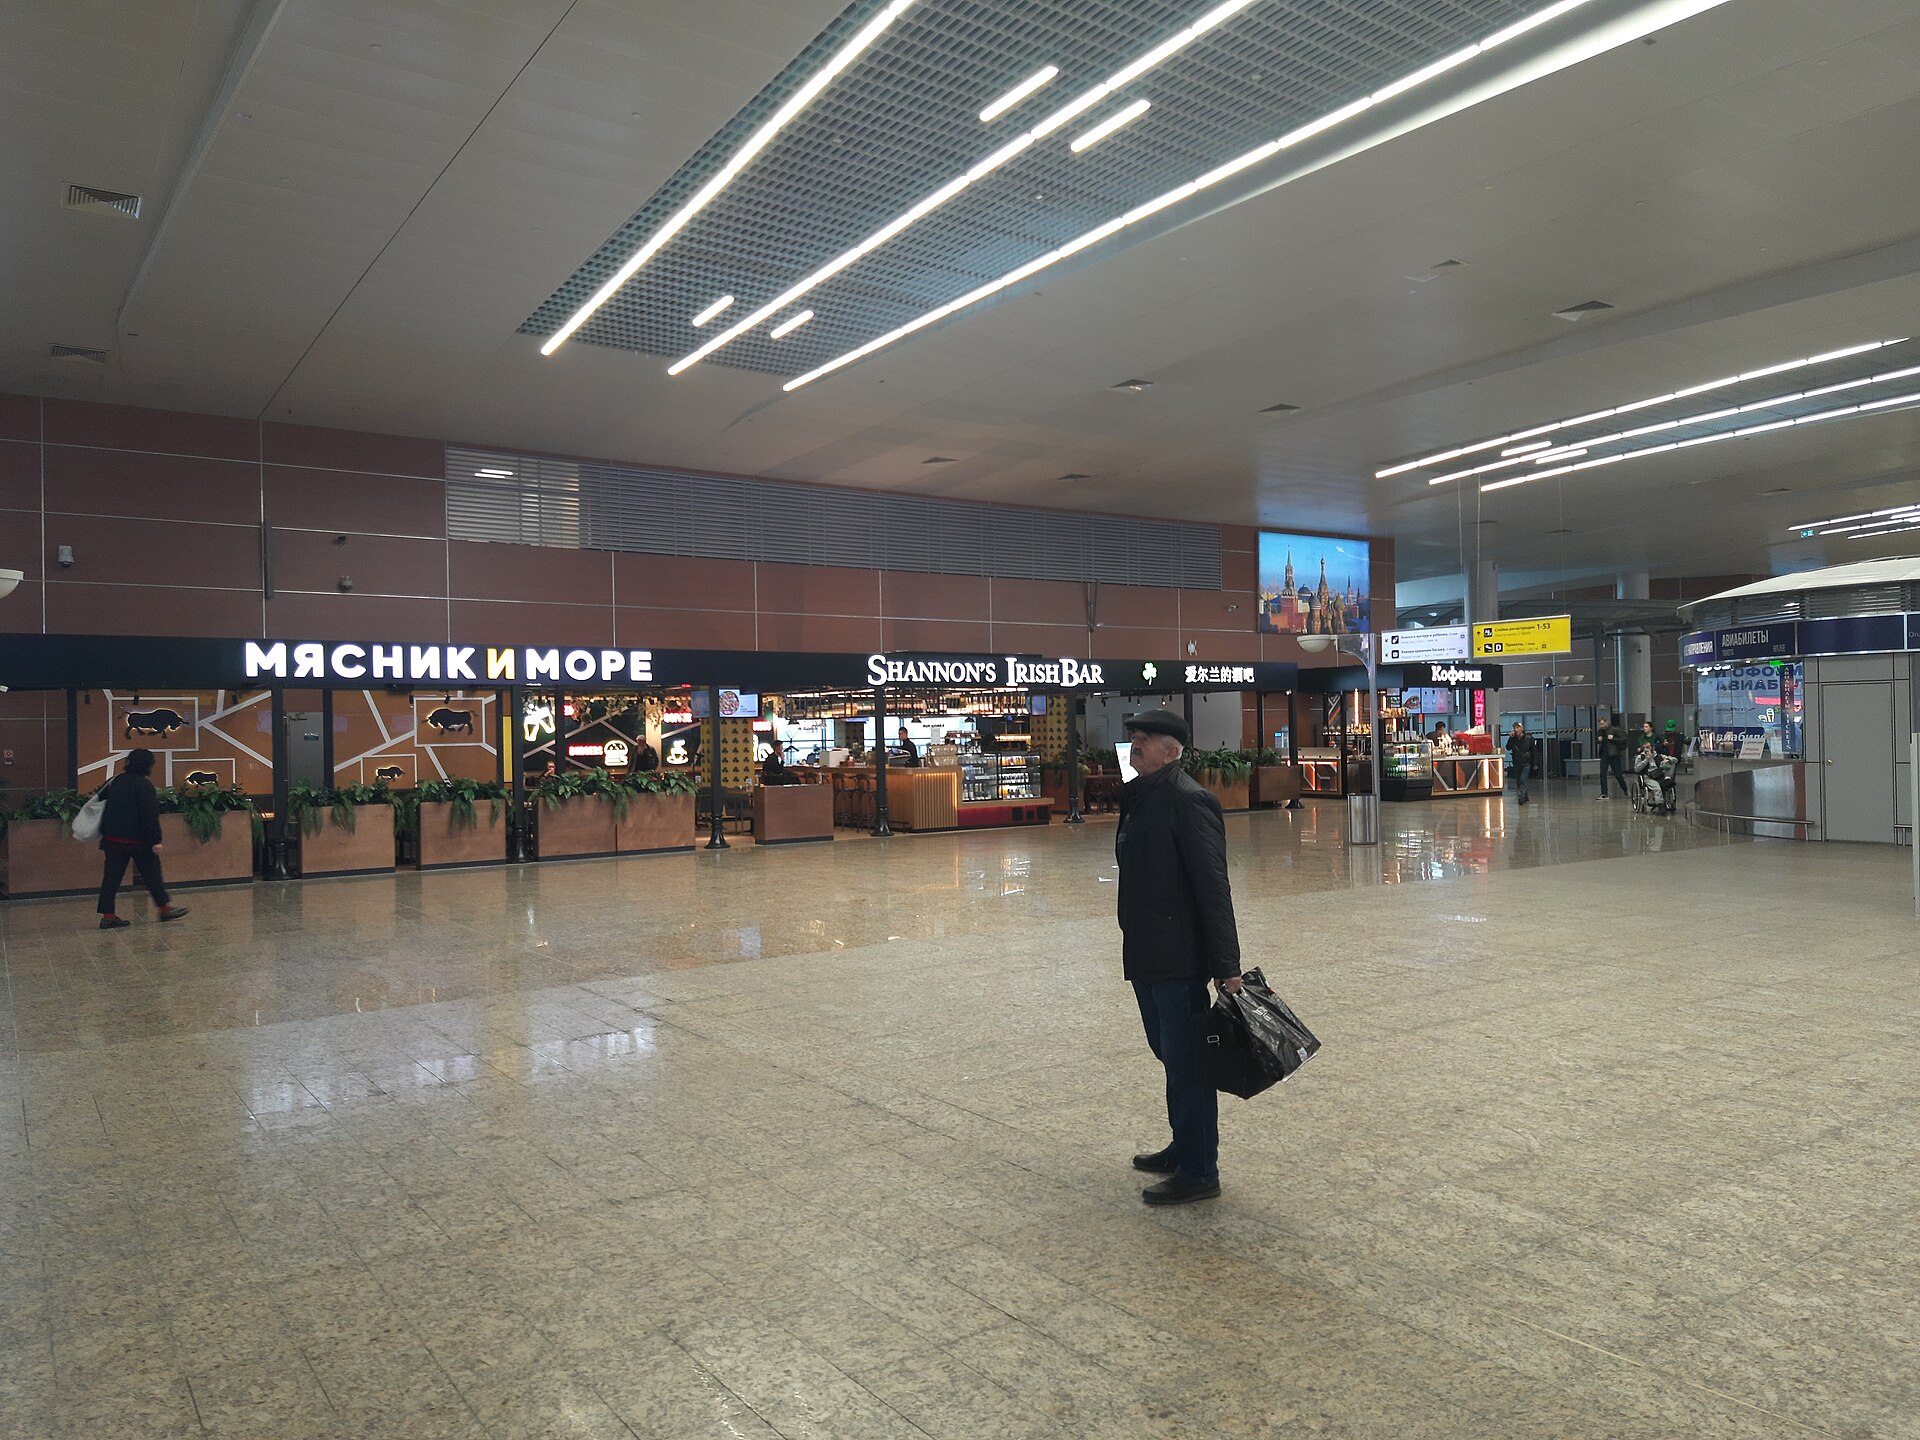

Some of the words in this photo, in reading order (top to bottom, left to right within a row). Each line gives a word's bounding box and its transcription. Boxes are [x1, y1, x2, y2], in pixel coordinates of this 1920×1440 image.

[1722, 630, 1769, 647] АВИАБИЛЕТЫ
[1495, 644, 1502, 652] D
[245, 642, 477, 679] МЯСНИК
[486, 648, 516, 680] И
[525, 648, 653, 681] МОРЕ
[867, 654, 997, 686] SHANNON'S
[1185, 665, 1255, 683] 爱尔兰的酒吧
